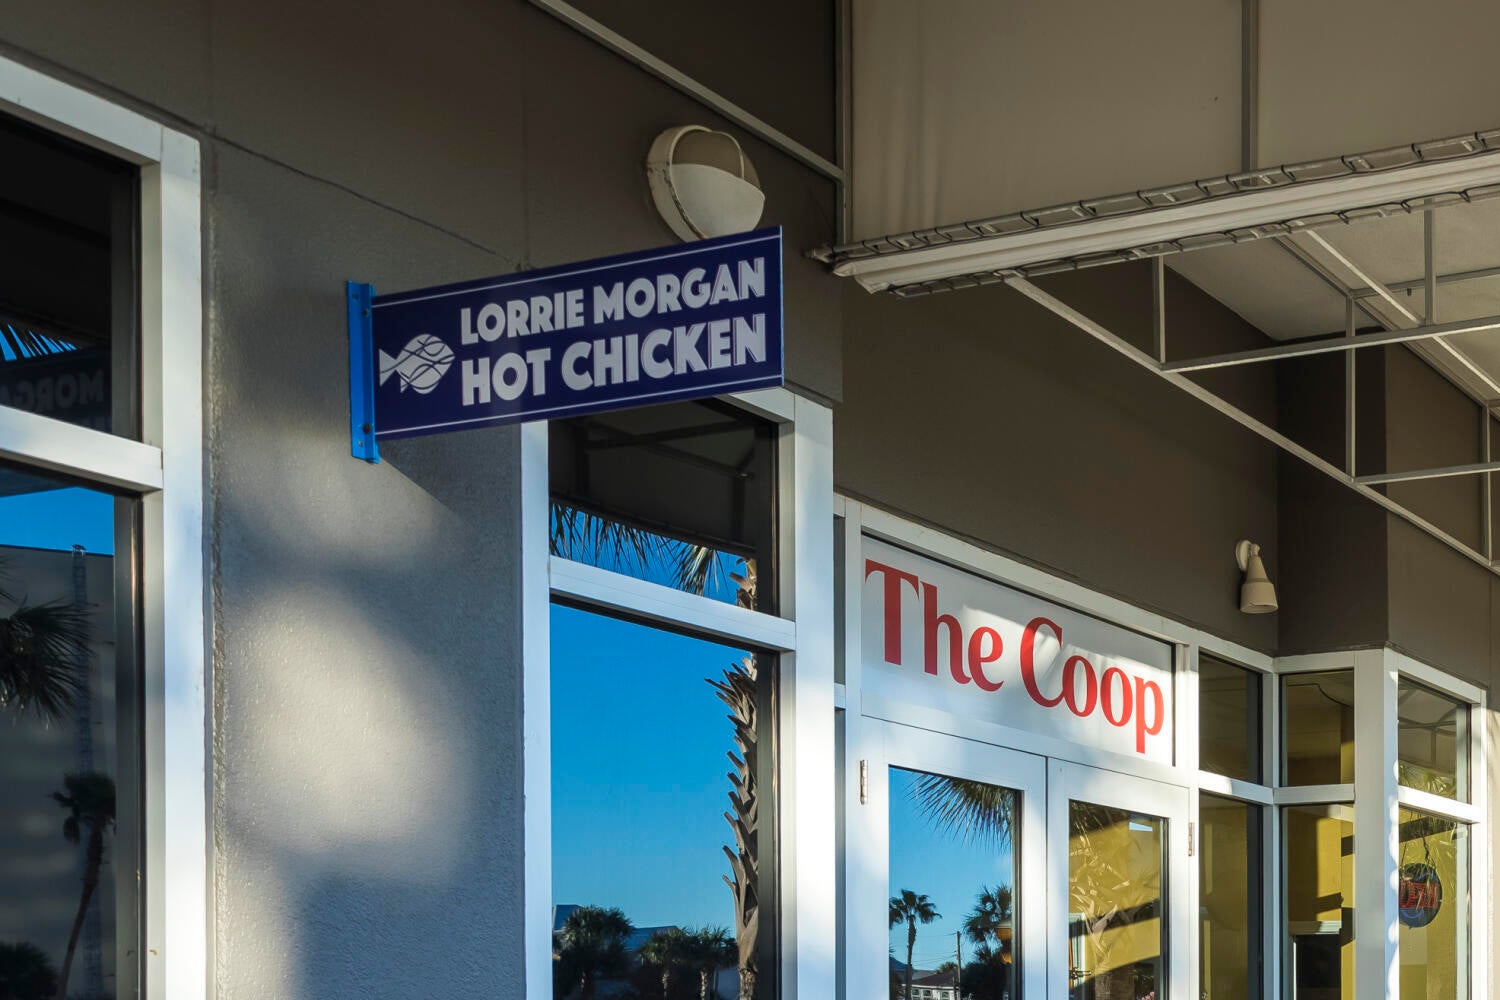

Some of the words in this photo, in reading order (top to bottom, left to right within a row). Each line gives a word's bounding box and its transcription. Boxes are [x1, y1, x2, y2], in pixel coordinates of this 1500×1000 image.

[461, 288, 584, 345] LORRIE
[594, 257, 765, 324] MORGAN
[462, 348, 551, 406] HOT
[561, 313, 766, 391] CHICKEN
[864, 558, 1004, 692] The
[1019, 616, 1164, 754] Coop
